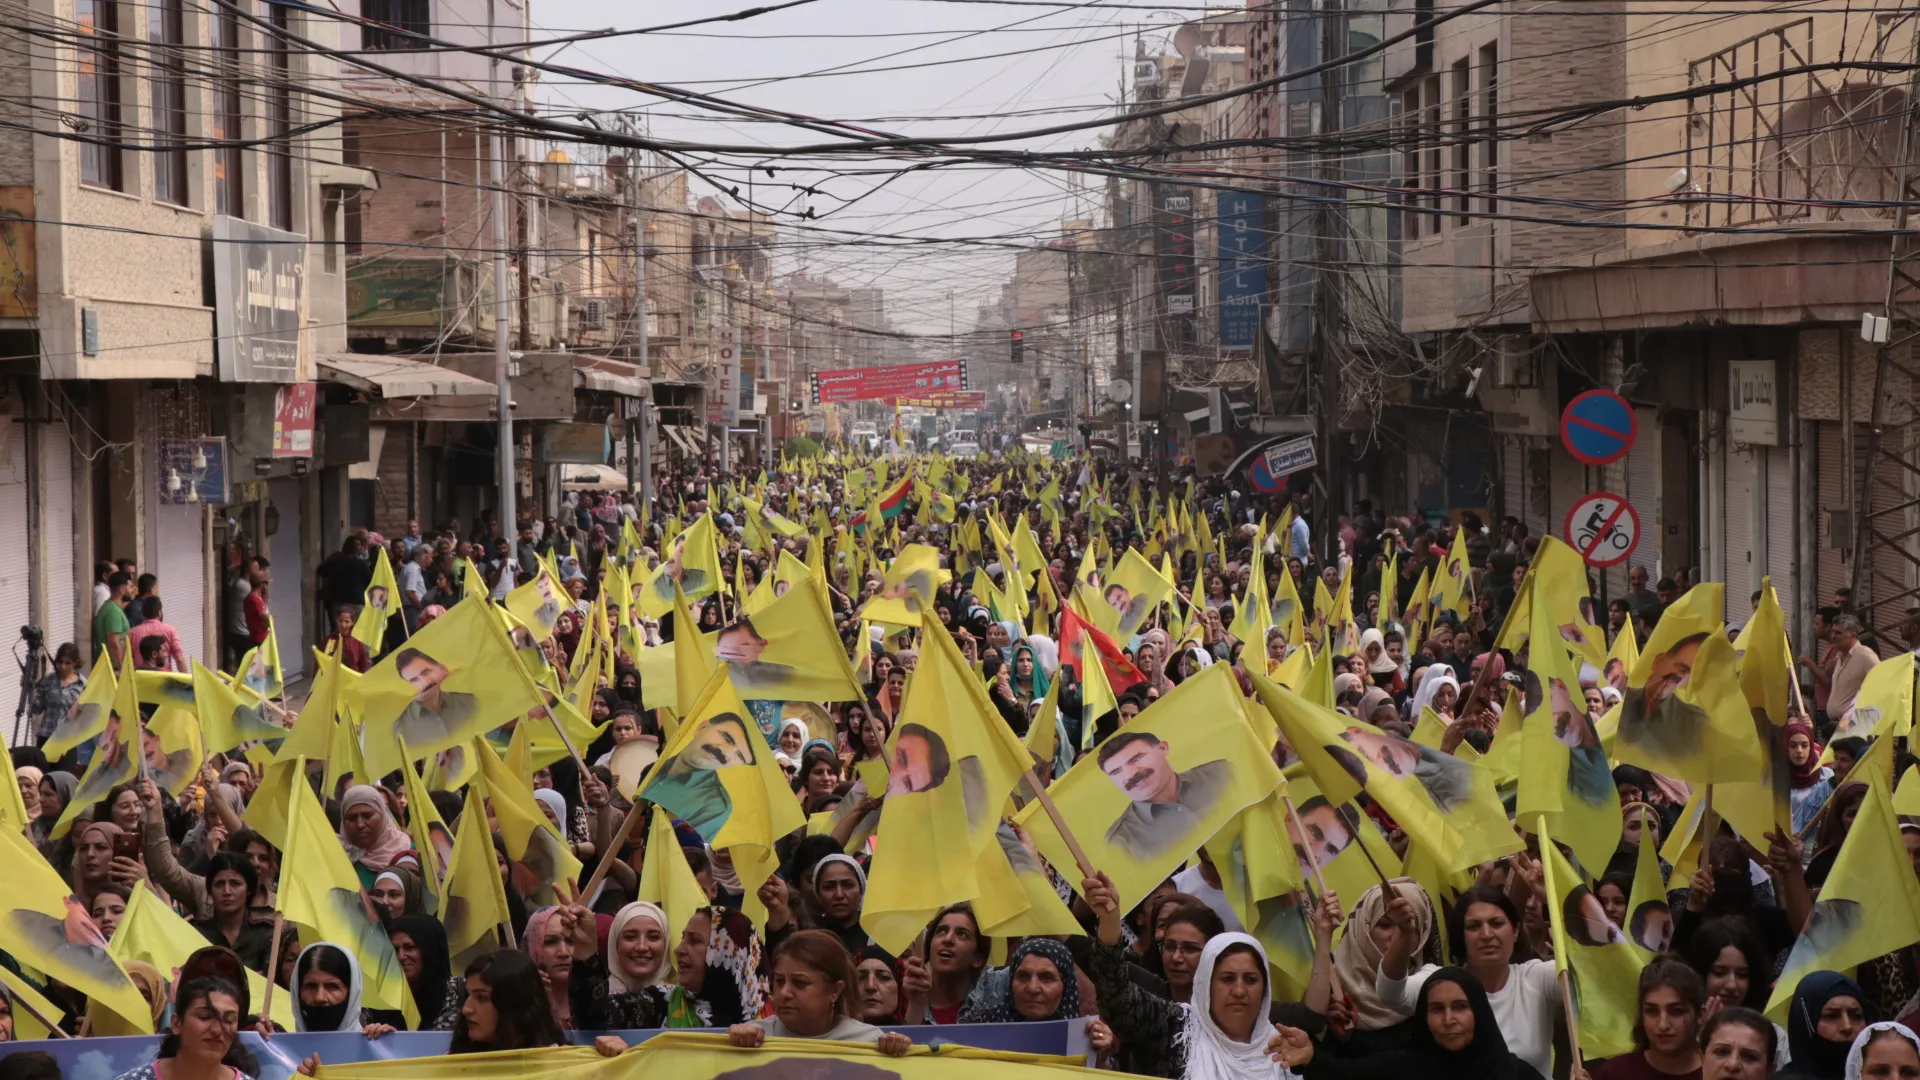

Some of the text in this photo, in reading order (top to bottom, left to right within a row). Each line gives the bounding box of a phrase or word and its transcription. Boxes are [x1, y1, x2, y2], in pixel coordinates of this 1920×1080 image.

[1234, 201, 1248, 288] HOTEL
[1225, 295, 1260, 306] ASIA
[720, 331, 733, 406] HOTEL
[917, 365, 959, 376] معرض
[1274, 449, 1312, 472] طبيب أسنان
